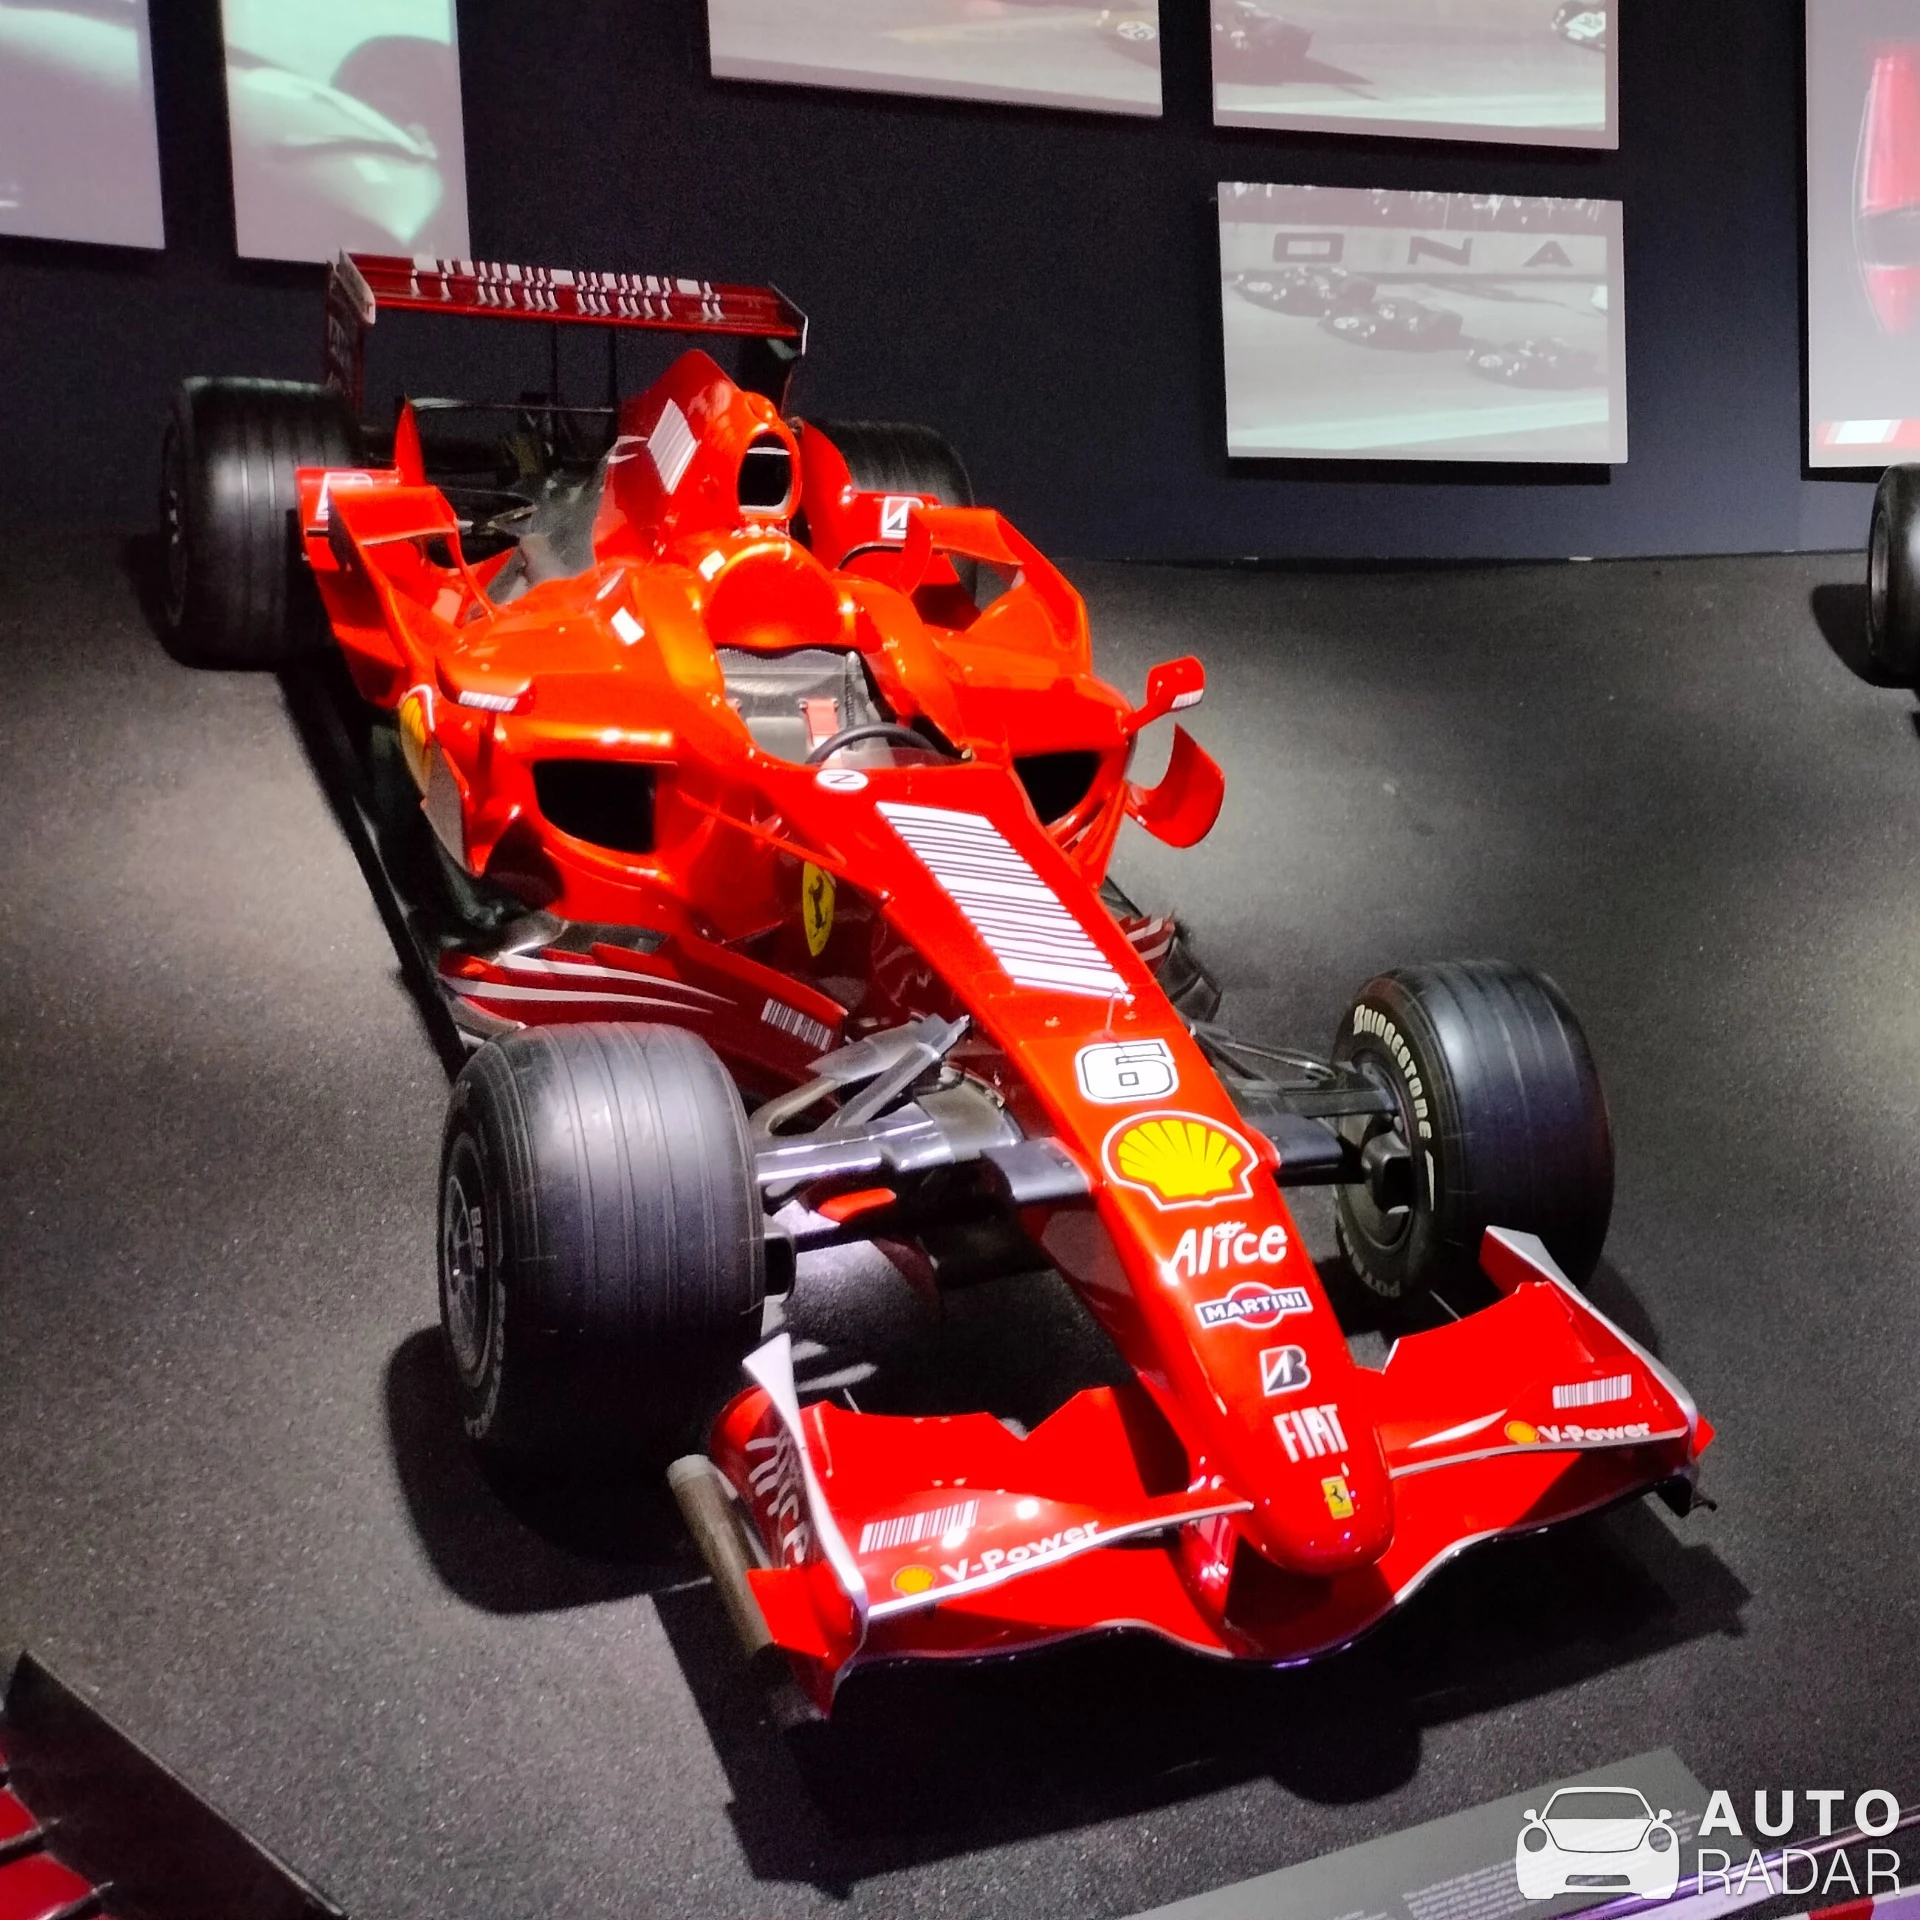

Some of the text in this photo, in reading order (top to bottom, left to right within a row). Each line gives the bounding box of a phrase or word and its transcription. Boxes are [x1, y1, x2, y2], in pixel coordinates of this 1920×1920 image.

[1075, 1038, 1179, 1104] 6
[1161, 1221, 1288, 1286] Alice
[1204, 1292, 1305, 1322] MARTINI
[1273, 1403, 1350, 1463] FIAT
[1537, 1421, 1651, 1443] V-Power
[940, 1519, 1101, 1583] V-Power
